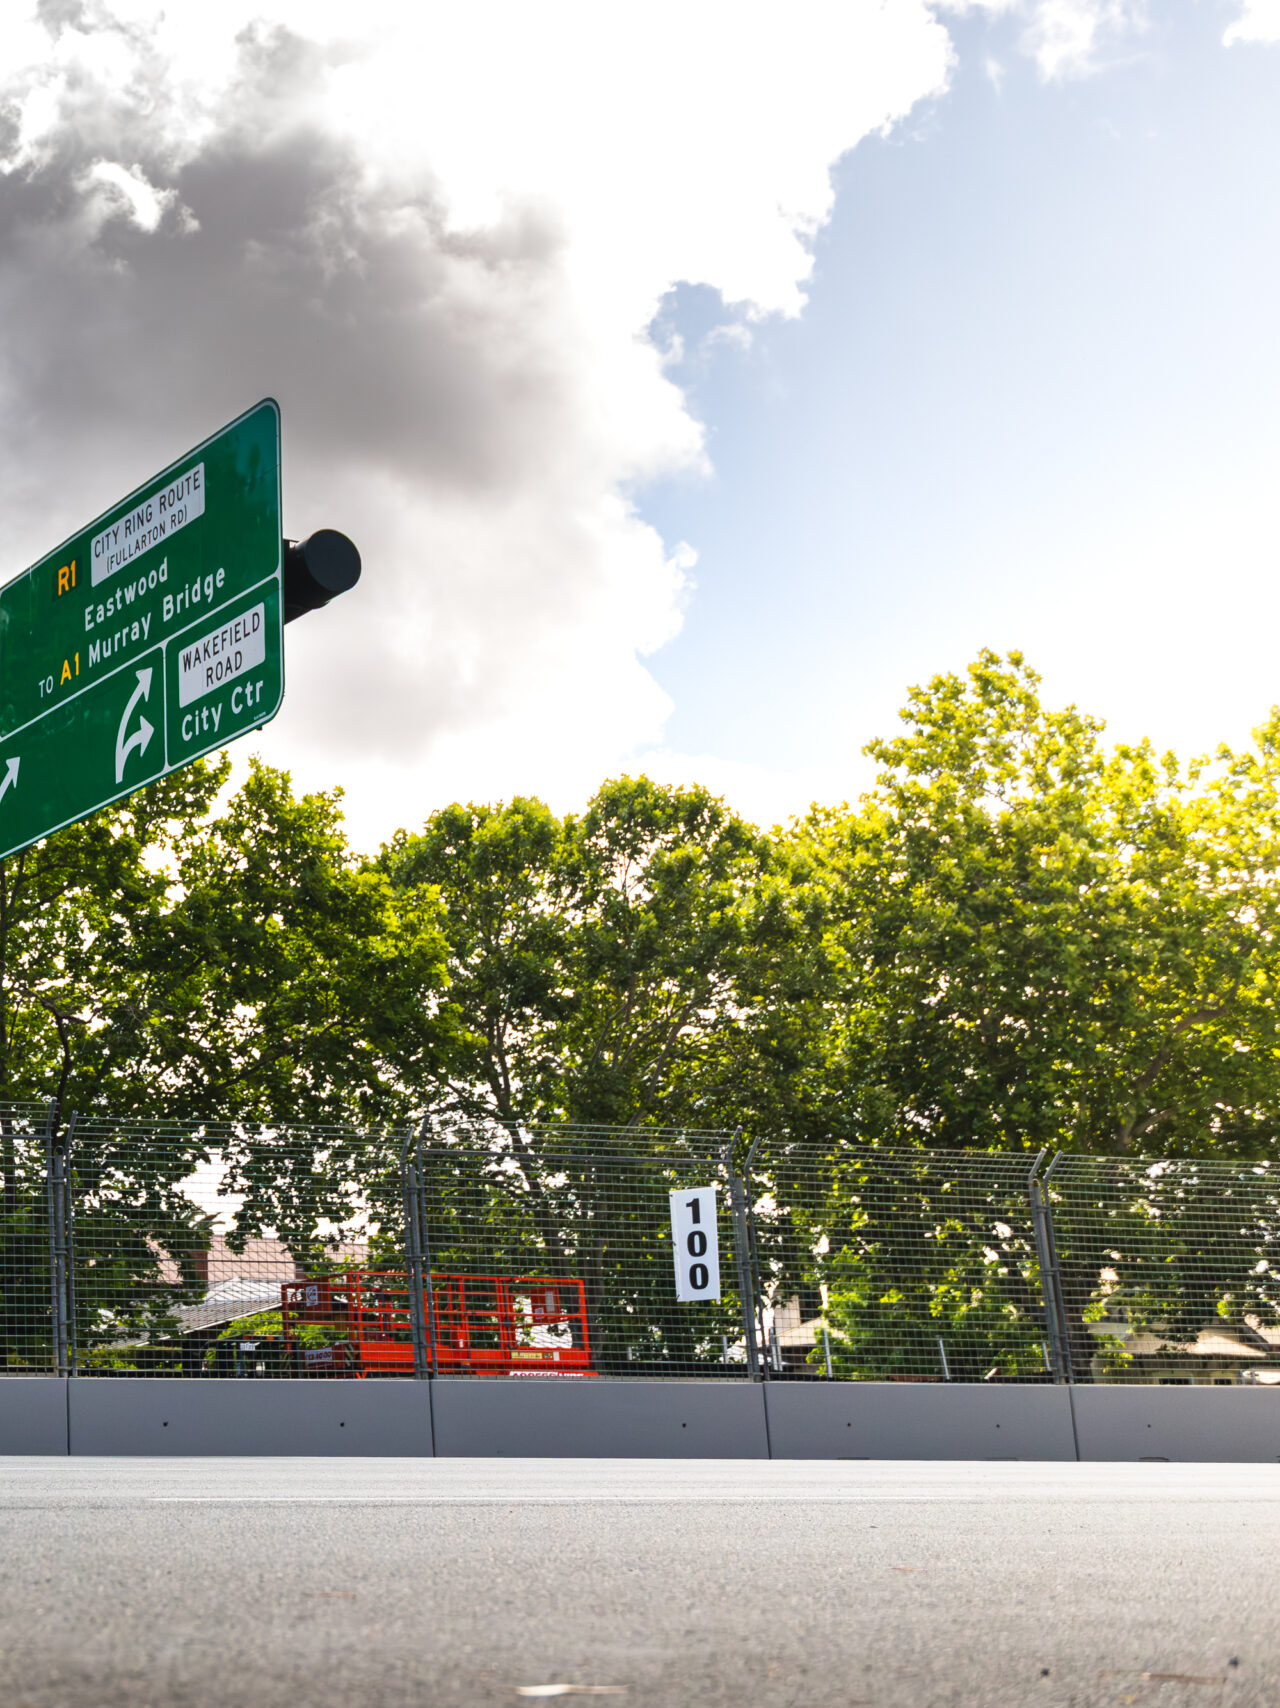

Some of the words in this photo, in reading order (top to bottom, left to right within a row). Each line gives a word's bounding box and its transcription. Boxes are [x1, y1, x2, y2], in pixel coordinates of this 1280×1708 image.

[94, 526, 120, 558] CITY
[124, 504, 153, 538] RING
[159, 470, 201, 514] ROUTE
[106, 521, 166, 573] (FULLARTON
[170, 504, 187, 530] RD)
[58, 560, 76, 596] R1
[84, 556, 168, 631] Eastwood
[39, 675, 54, 698] TO
[60, 652, 80, 686] A1
[88, 612, 151, 668] Murray
[163, 567, 225, 622] Bridge
[183, 612, 260, 672] WAKEFIELD
[206, 651, 243, 687] ROAD
[182, 703, 222, 741] City
[231, 680, 264, 714] Ctr
[686, 1197, 709, 1290] 100
